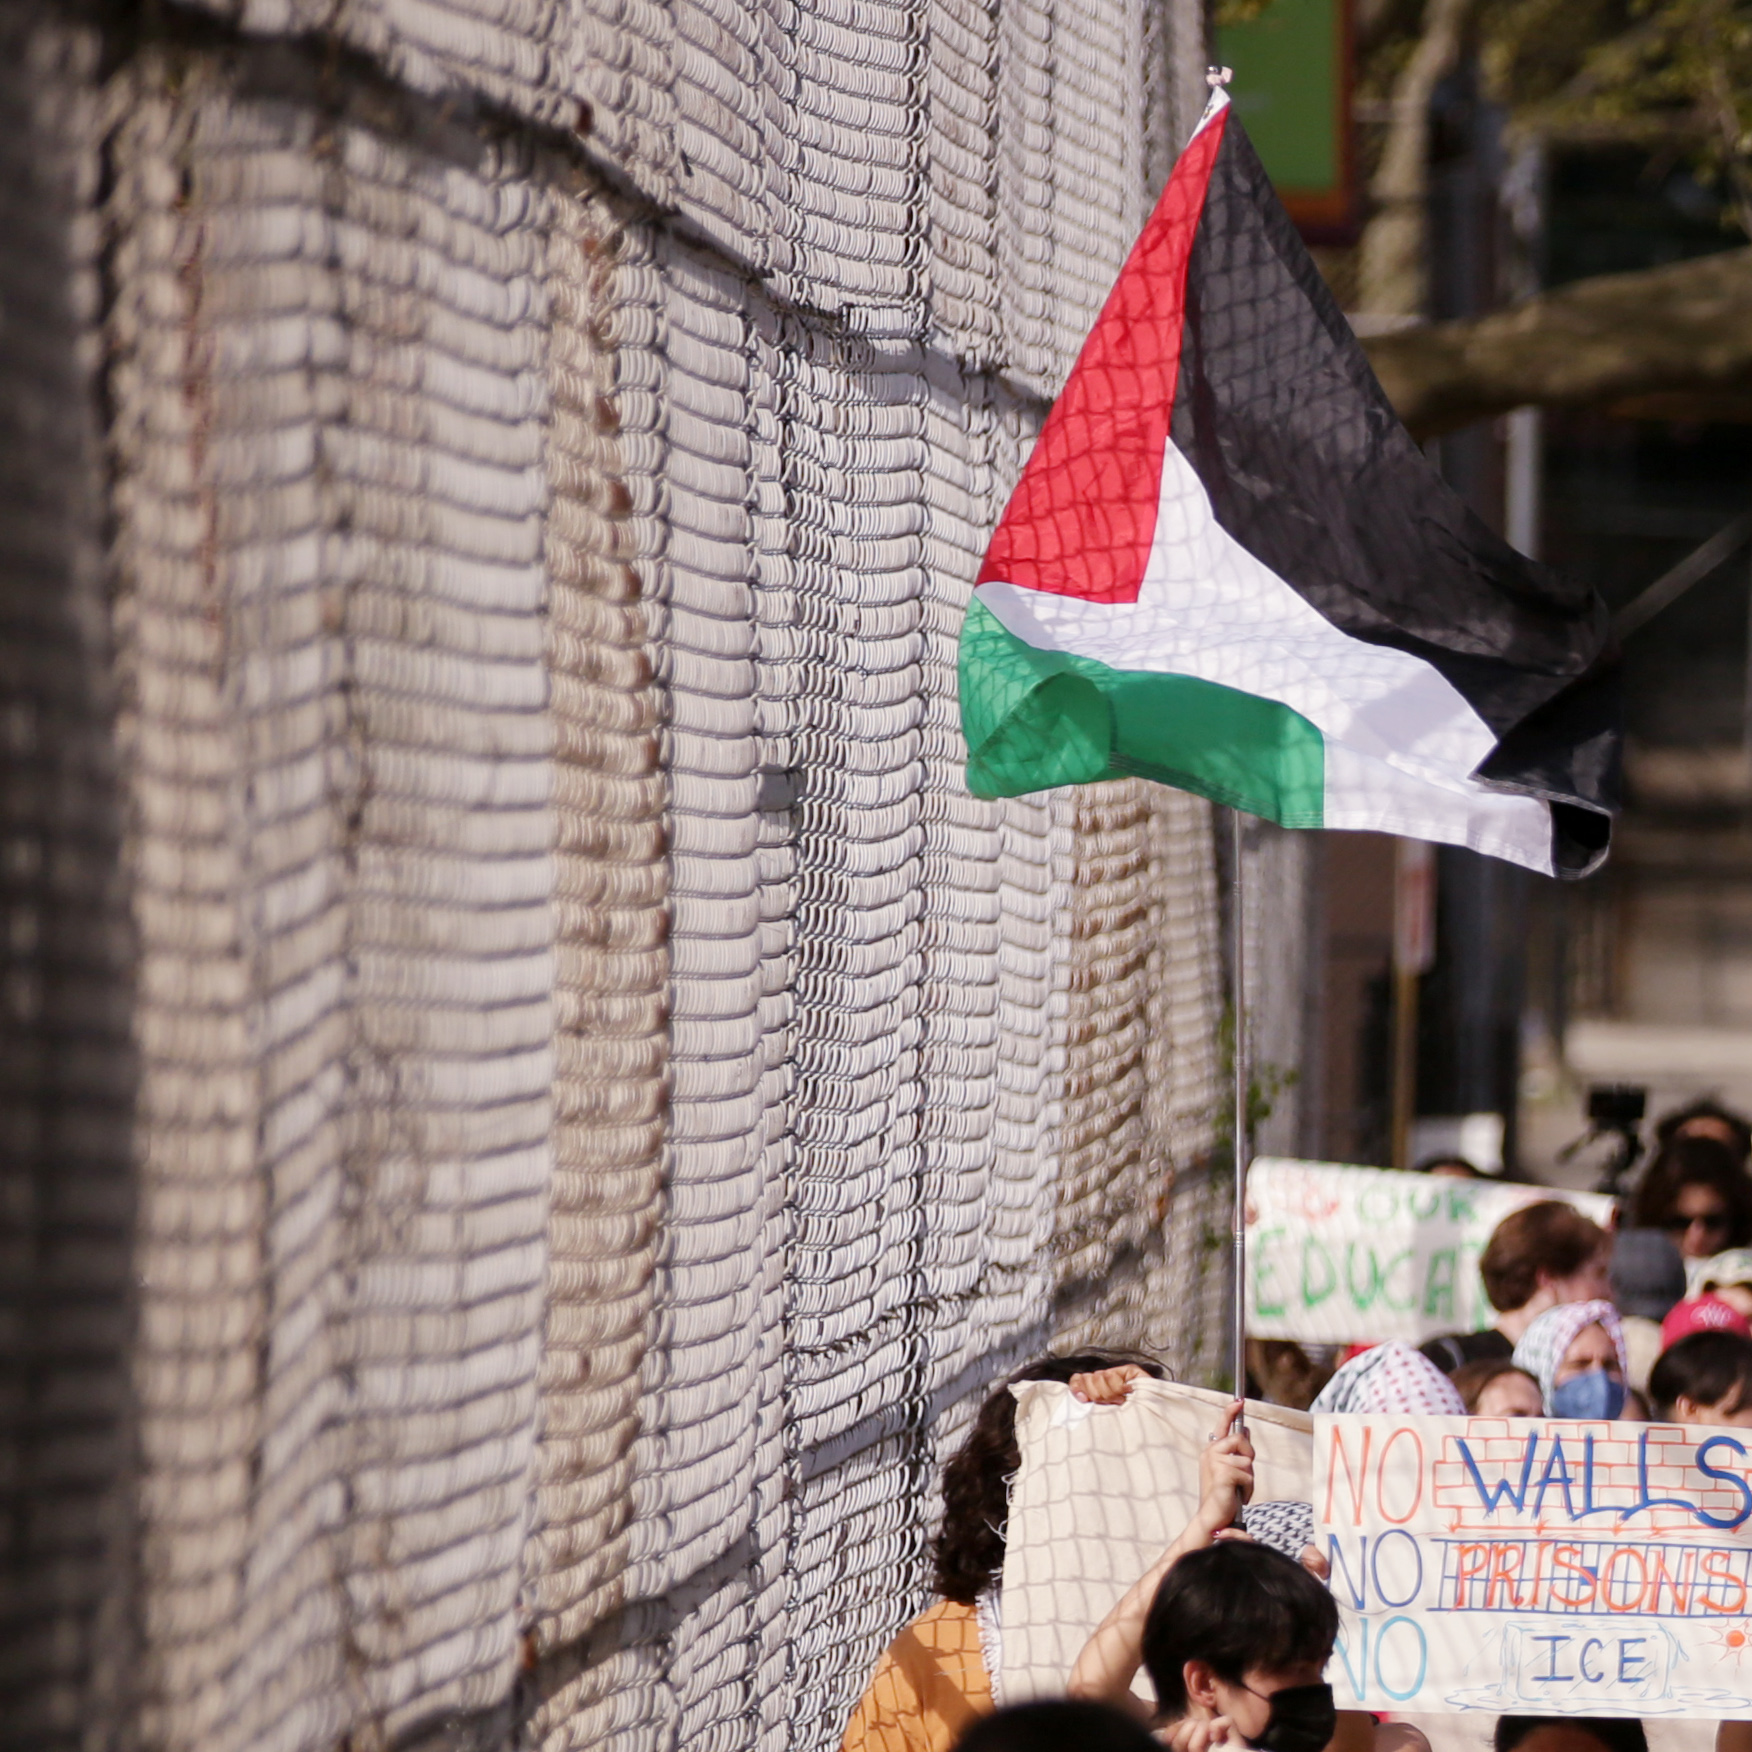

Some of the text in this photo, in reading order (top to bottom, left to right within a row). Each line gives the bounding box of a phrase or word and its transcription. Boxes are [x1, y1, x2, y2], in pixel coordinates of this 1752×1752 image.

[1322, 1424, 1752, 1529] NO WALLS
[1326, 1529, 1748, 1614] NO PRISONS
[1332, 1615, 1648, 1702] NO ICE
